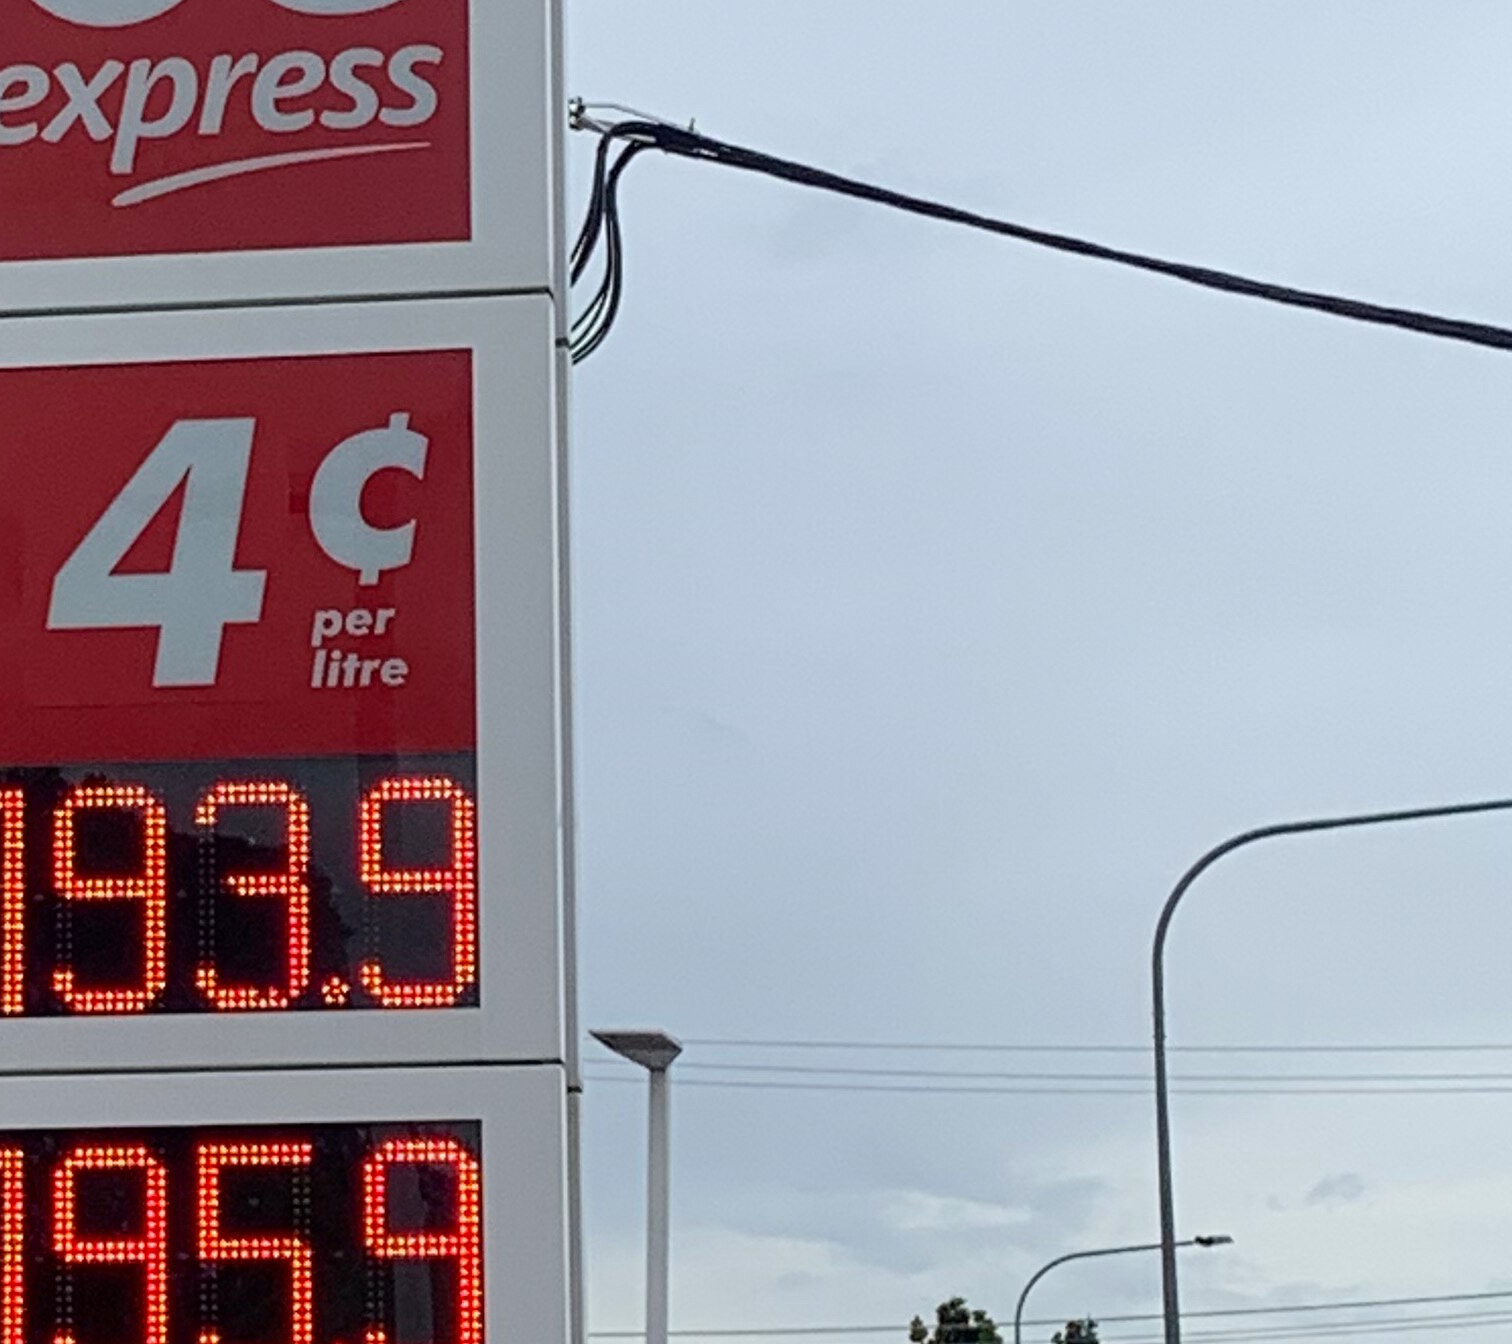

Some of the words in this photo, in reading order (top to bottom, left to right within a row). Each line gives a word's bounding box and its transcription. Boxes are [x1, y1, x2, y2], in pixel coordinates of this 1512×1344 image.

[46, 417, 267, 688] 4
[311, 603, 396, 647] per
[310, 648, 409, 688] litre
